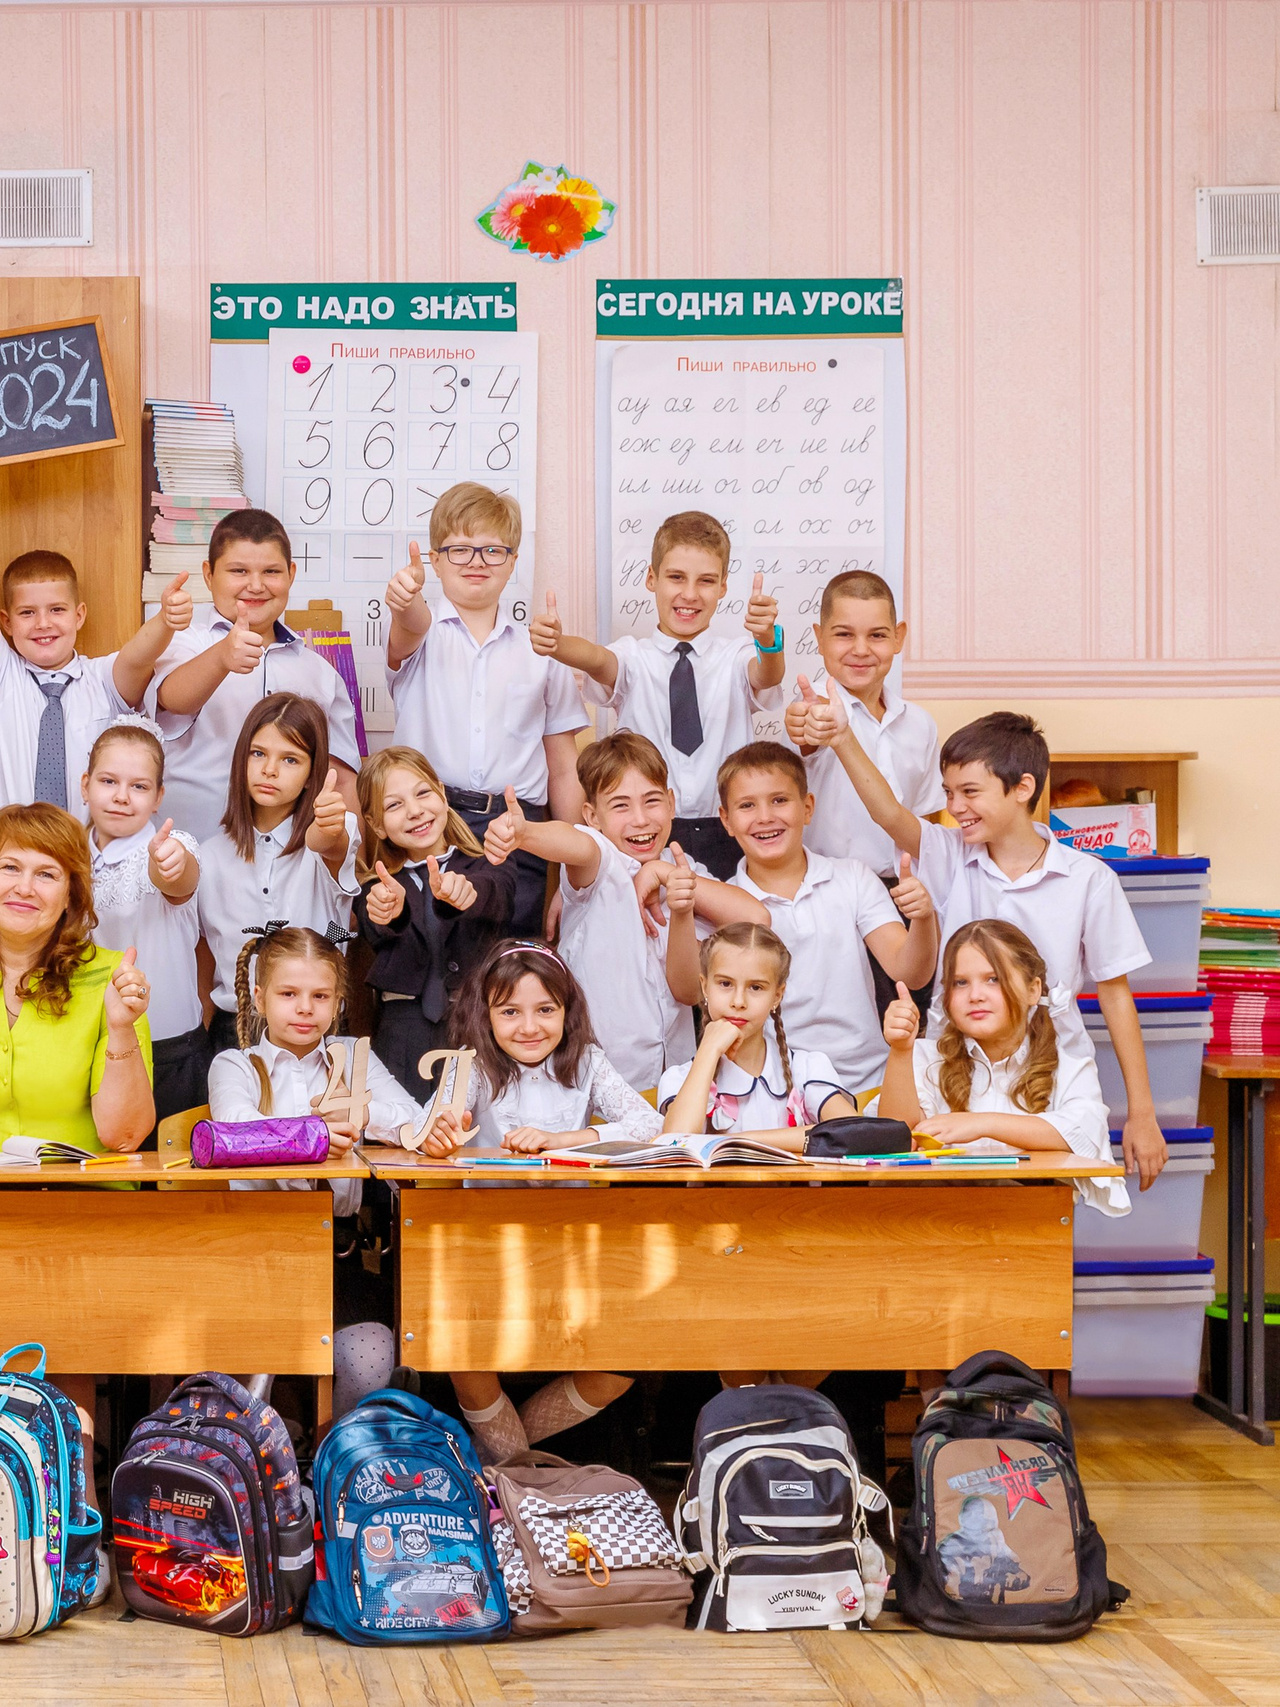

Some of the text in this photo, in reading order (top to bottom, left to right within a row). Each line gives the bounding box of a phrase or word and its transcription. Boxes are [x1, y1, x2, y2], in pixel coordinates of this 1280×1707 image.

[212, 295, 516, 324] ЭТО НАДО ЗНАТЬ
[597, 291, 902, 320] СЕГОДНЯ НА УРОКЕ
[308, 363, 520, 413] 1 2 3 4
[618, 397, 650, 425] ау
[664, 397, 695, 413] ая
[755, 385, 787, 413] ев
[803, 397, 831, 425] ед
[852, 397, 876, 412] ее
[298, 420, 520, 471] 5 6 7 8
[669, 438, 696, 465] ез
[841, 425, 876, 453] ив
[299, 477, 331, 525] 9
[367, 599, 527, 622] 3 6
[1073, 831, 1114, 850] ЧУДО
[149, 1498, 207, 1520] SPEED
[173, 1491, 213, 1509] HIGH
[383, 1512, 465, 1531] ADVENTURE
[428, 1526, 474, 1541] MAKSIMM
[767, 1589, 827, 1605] LUCKY SUNDAY
[375, 1616, 431, 1629] RIDE CITY
